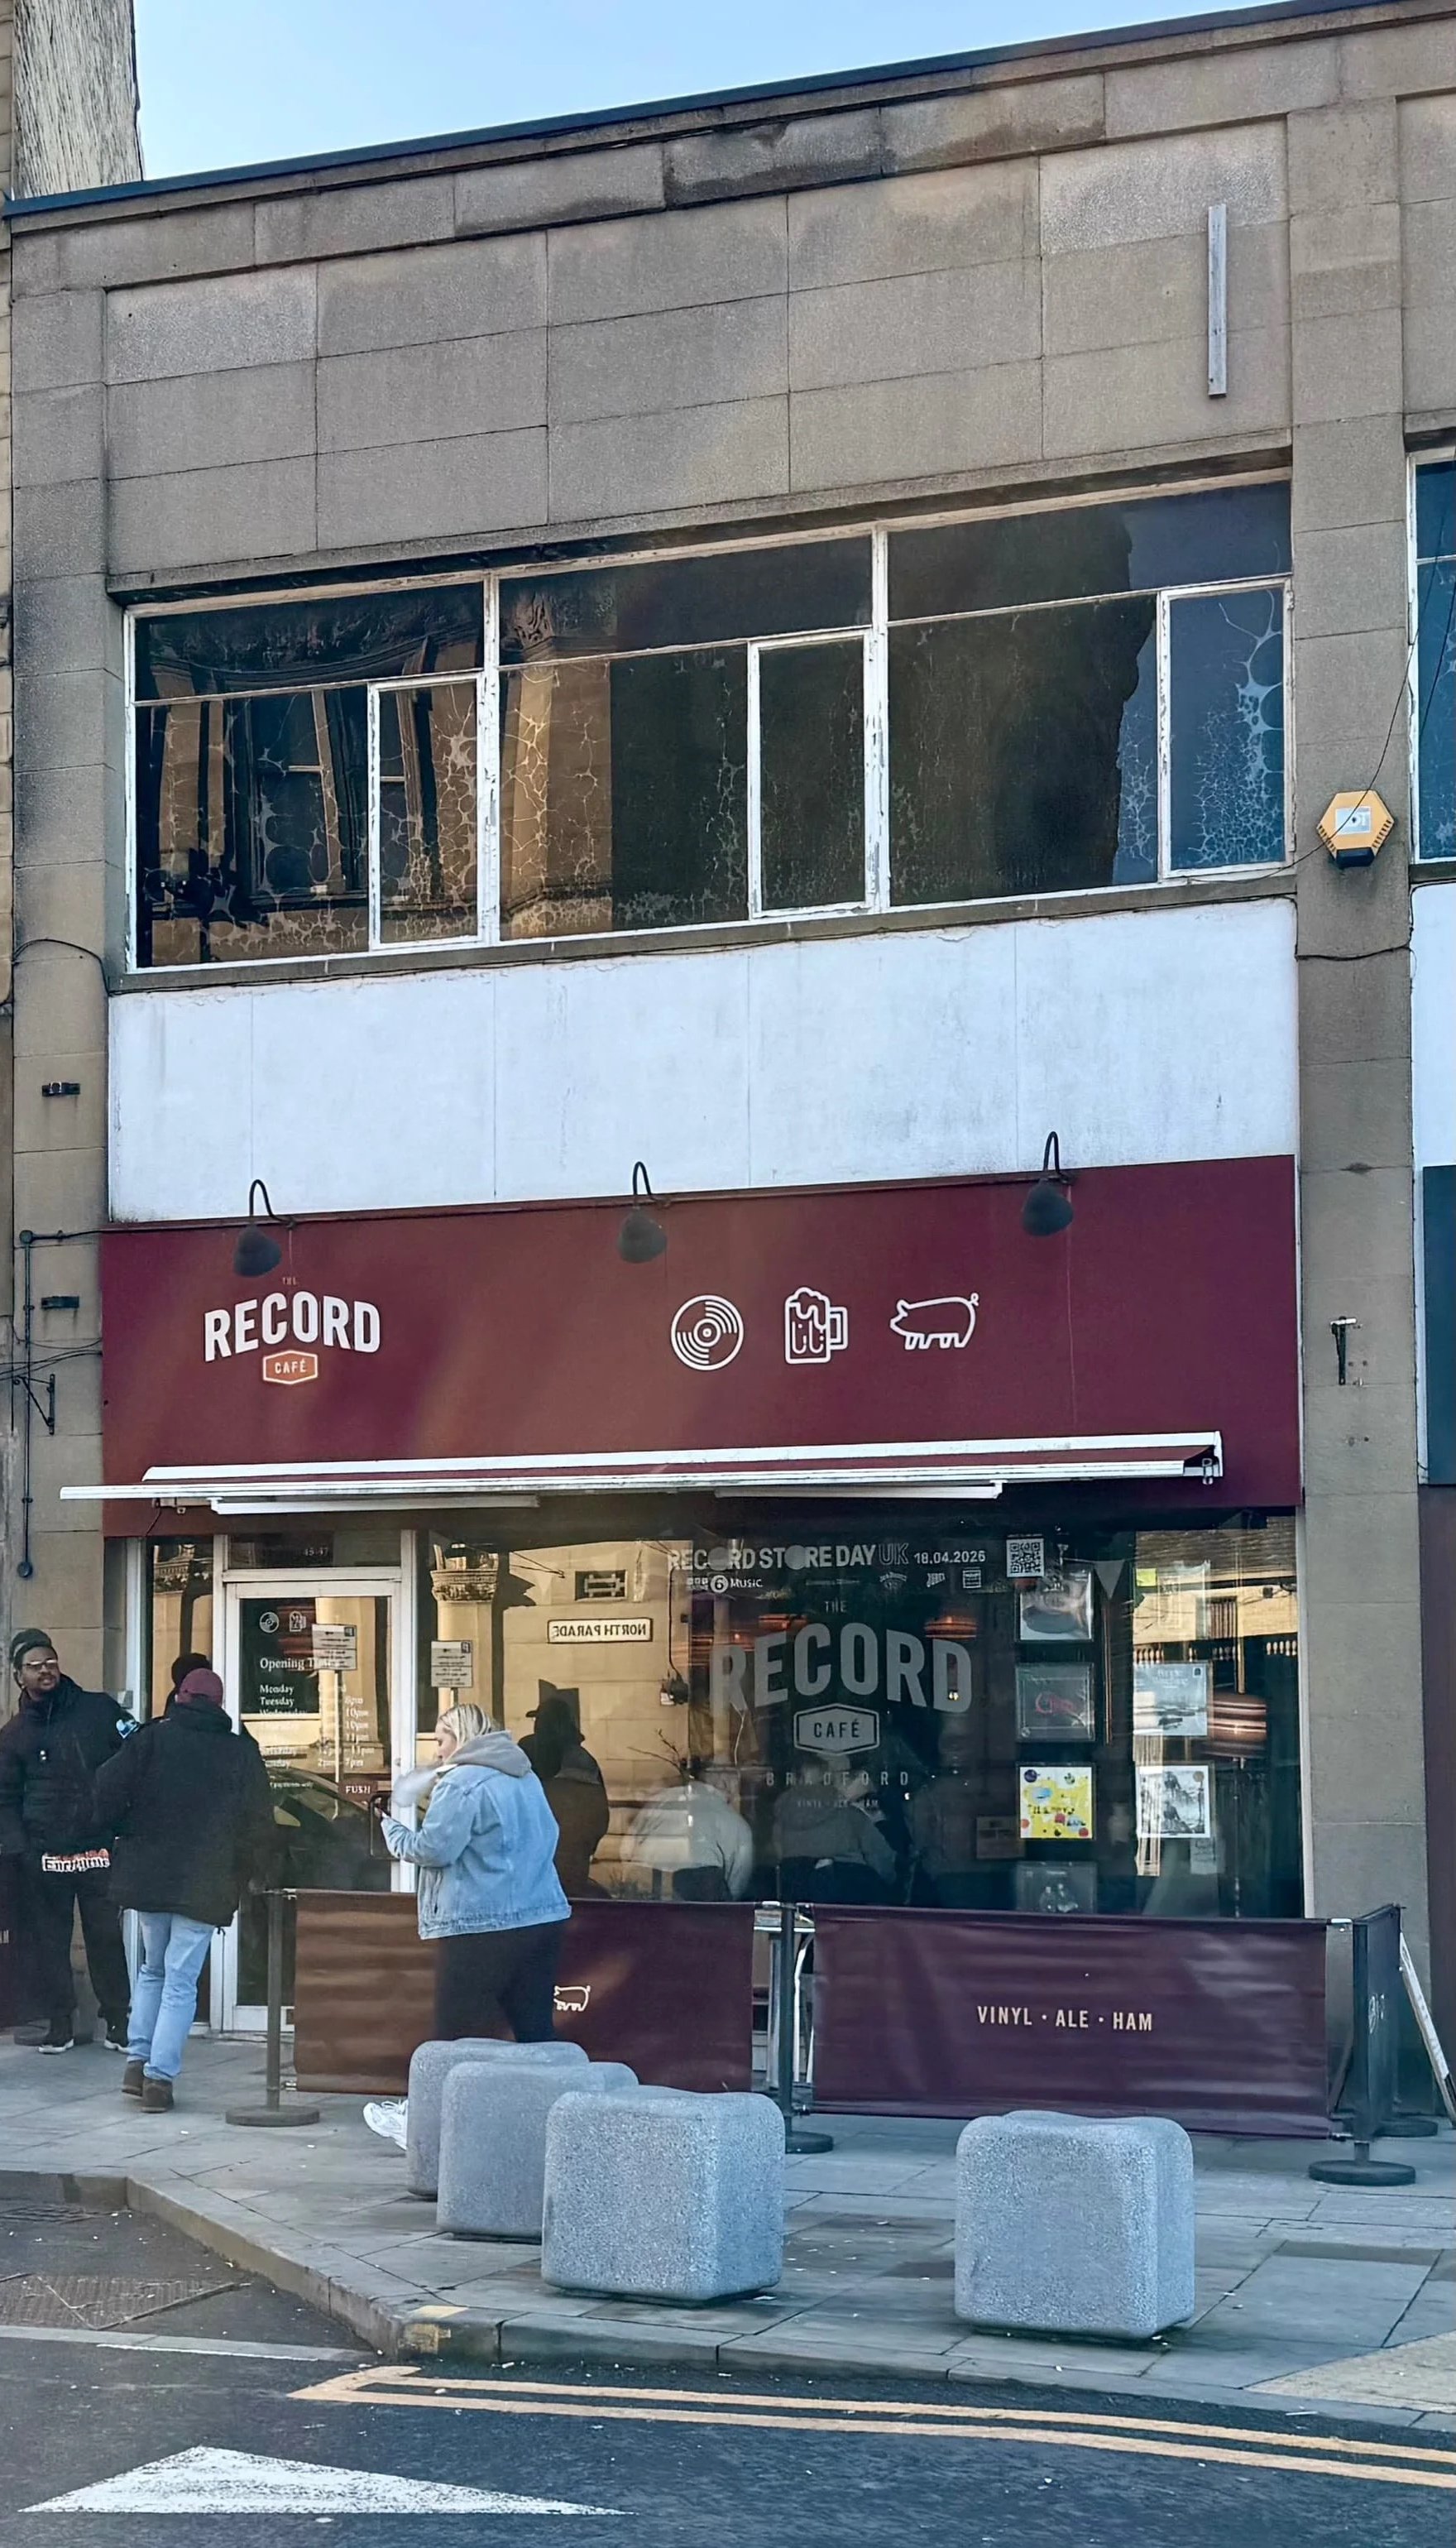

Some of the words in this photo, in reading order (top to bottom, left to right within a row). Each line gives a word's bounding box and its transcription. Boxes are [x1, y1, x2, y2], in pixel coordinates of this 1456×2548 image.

[204, 1291, 381, 1362] RECORD
[275, 1359, 307, 1375] CAFÉ
[668, 1547, 756, 1571] RECORD
[759, 1545, 833, 1570] STORE
[836, 1544, 876, 1567] DAY
[879, 1543, 909, 1565] UK
[914, 1550, 986, 1564] 18.04.2026
[825, 1600, 847, 1614] THE
[260, 1658, 305, 1672] Opening
[711, 1622, 972, 1714] RECORD
[259, 1685, 295, 1696] Monday
[260, 1696, 295, 1708] Tuesday
[813, 1717, 860, 1739] CAFÉ
[766, 1770, 908, 1786] BRADFORD
[977, 2005, 1032, 2025] VINYL
[1056, 2009, 1090, 2028] ALE
[1113, 2012, 1152, 2032] HAM
